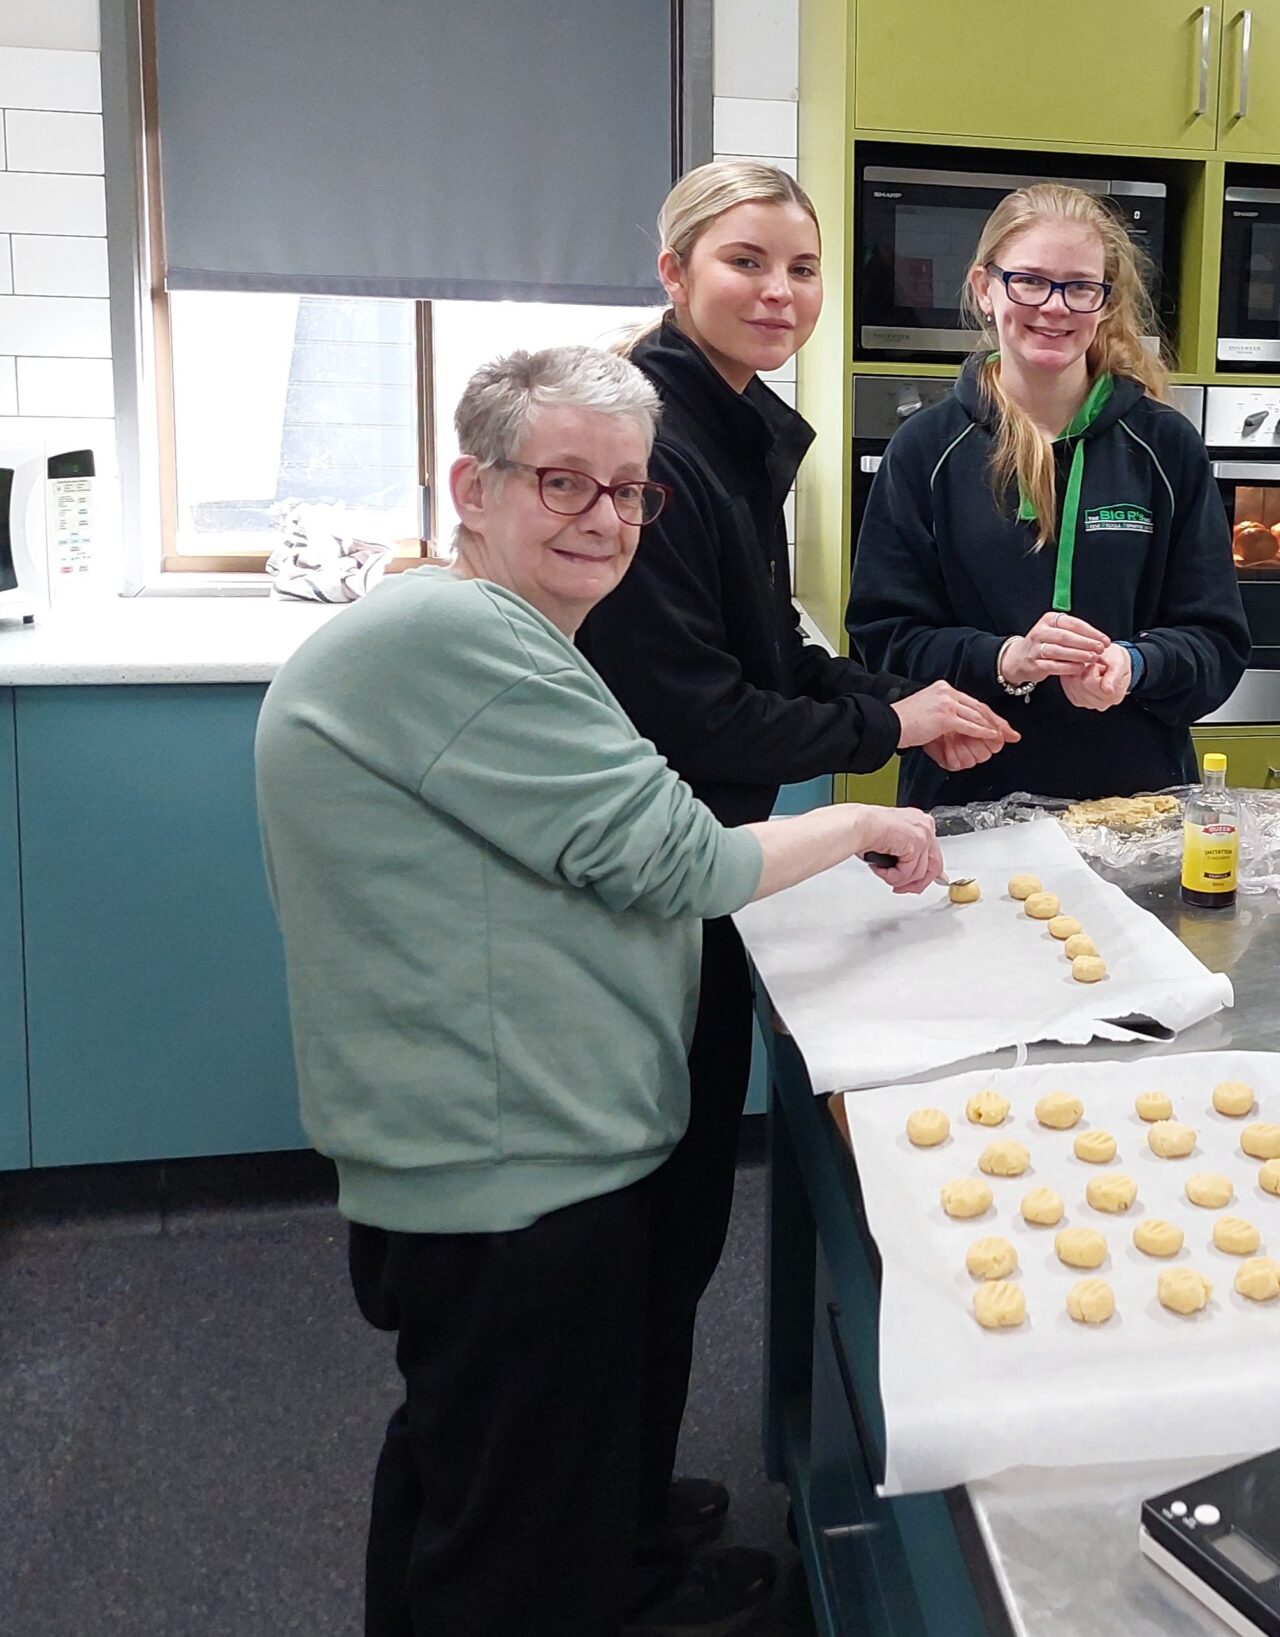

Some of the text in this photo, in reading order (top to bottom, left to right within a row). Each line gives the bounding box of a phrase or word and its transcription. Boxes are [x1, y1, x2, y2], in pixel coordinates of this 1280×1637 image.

[873, 191, 902, 199] SHARP
[1133, 210, 1140, 219] 0
[1100, 510, 1125, 520] BIG
